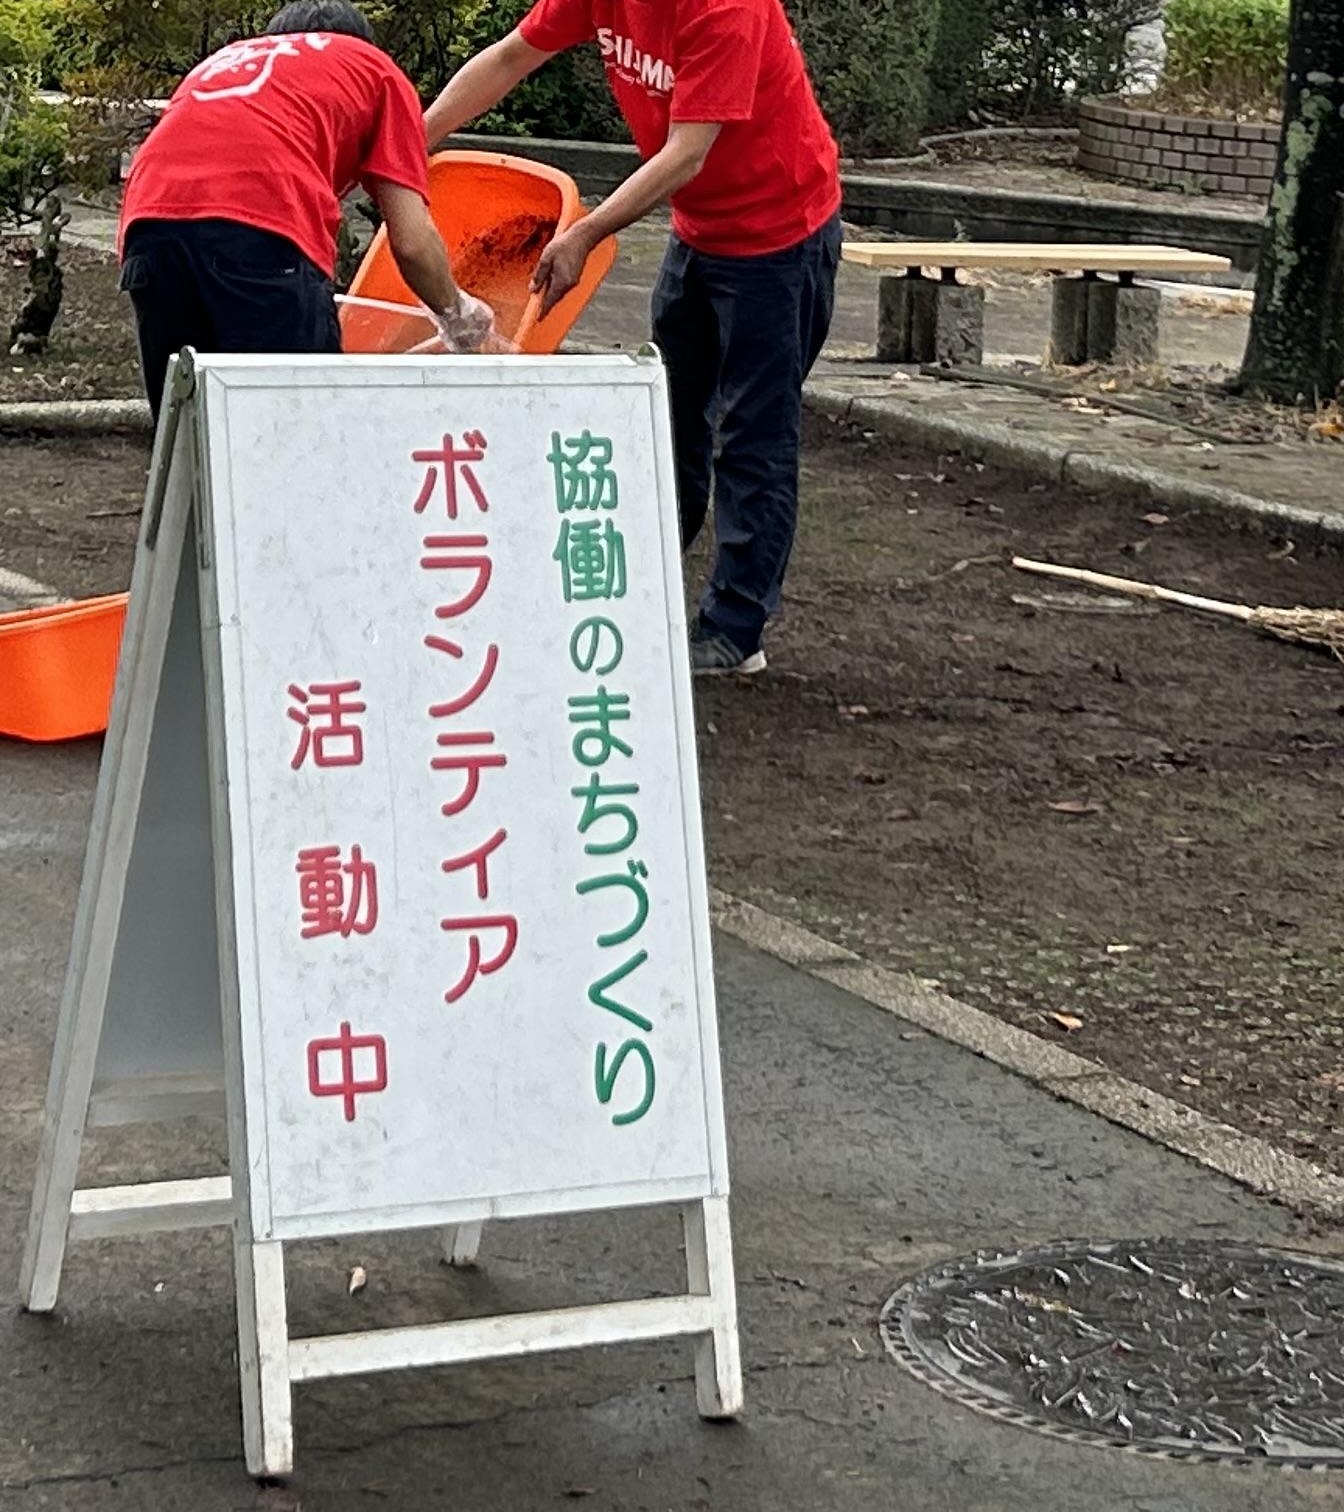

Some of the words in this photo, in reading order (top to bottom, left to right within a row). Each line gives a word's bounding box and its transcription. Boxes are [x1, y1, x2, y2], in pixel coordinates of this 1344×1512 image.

[288, 680, 388, 1122] 活動中
[411, 429, 518, 1003] ボランティア
[546, 430, 657, 1127] 協働のまちづくり
